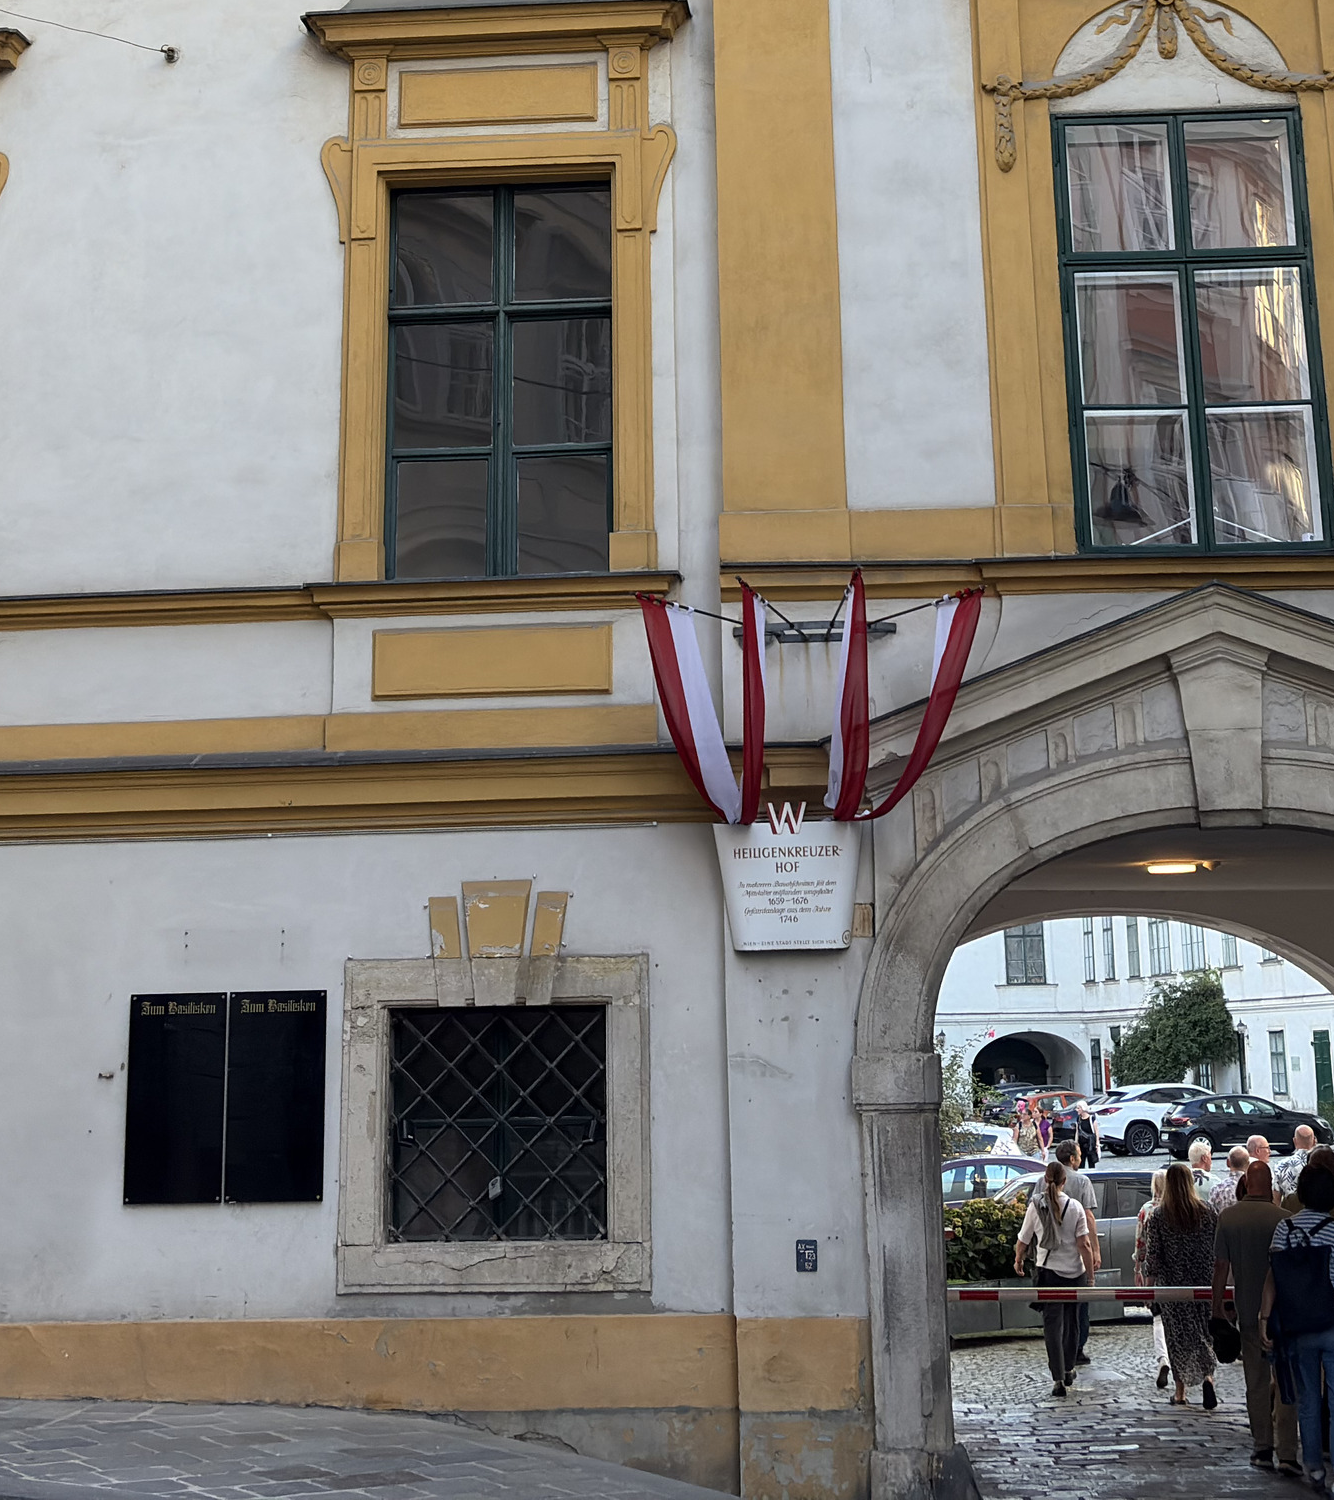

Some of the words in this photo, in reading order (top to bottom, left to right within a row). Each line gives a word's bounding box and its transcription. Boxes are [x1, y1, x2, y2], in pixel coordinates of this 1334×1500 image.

[767, 801, 806, 835] W
[733, 845, 843, 859] HEILIGENKREUZER-
[775, 861, 800, 873] HOF
[779, 915, 799, 924] 1746
